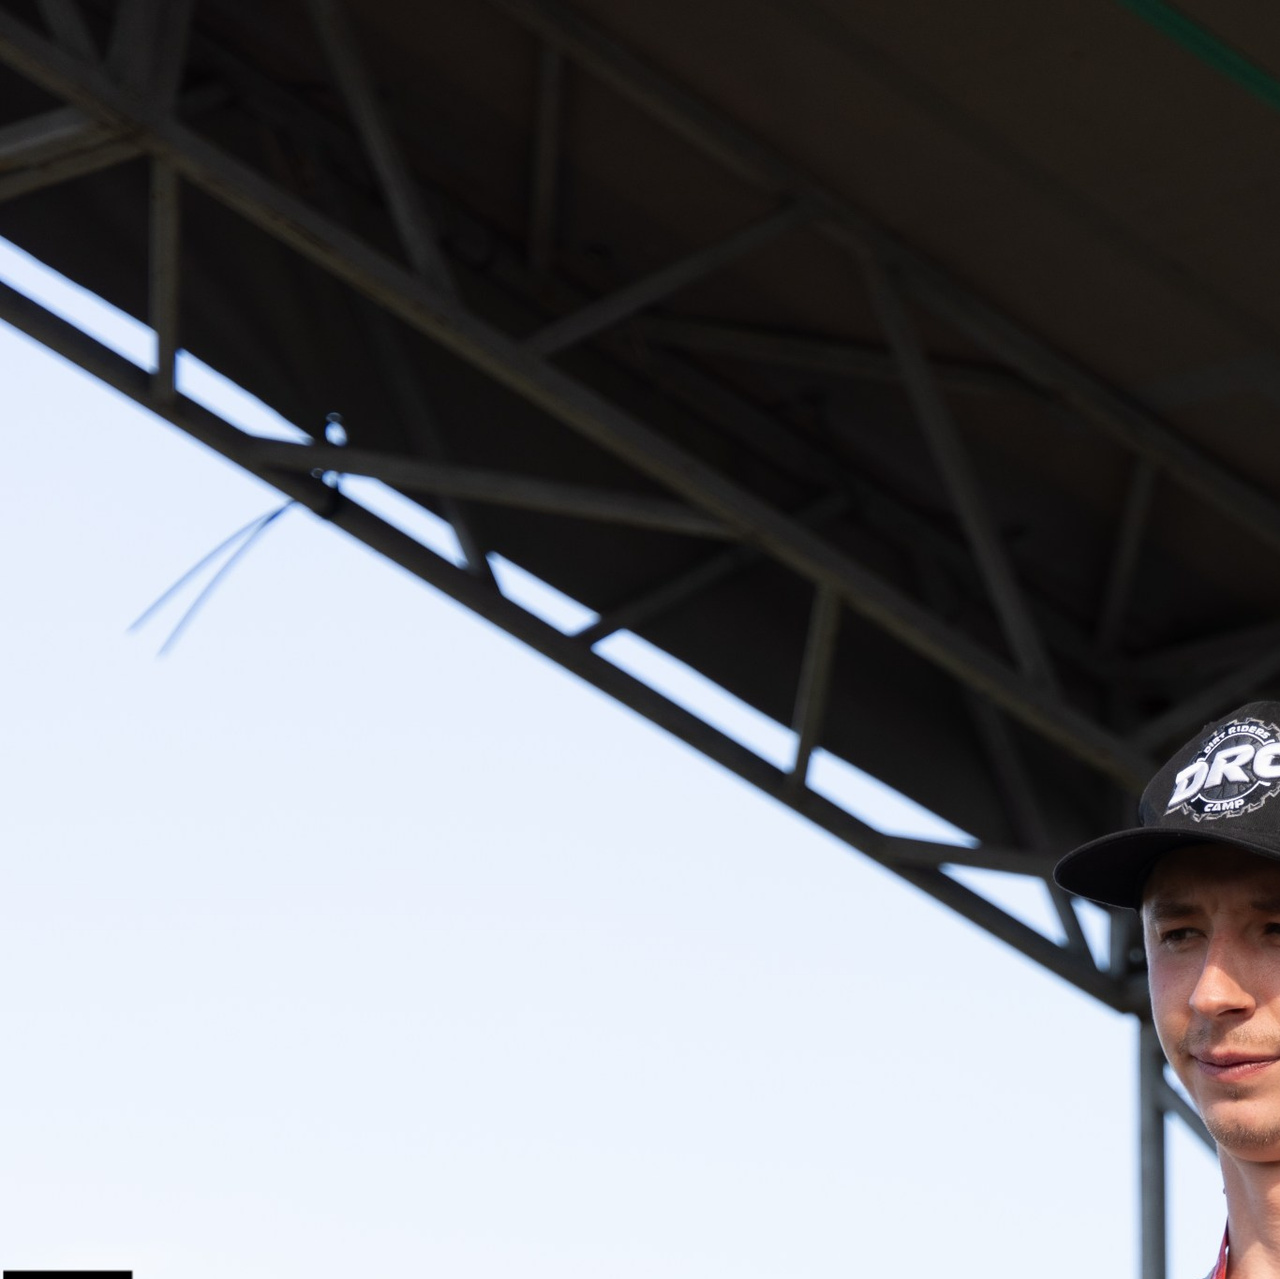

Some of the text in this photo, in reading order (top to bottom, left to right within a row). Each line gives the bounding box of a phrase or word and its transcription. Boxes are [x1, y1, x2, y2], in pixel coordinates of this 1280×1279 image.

[1204, 724, 1271, 754] DIRT RIDERS
[1203, 799, 1245, 813] CAMP
